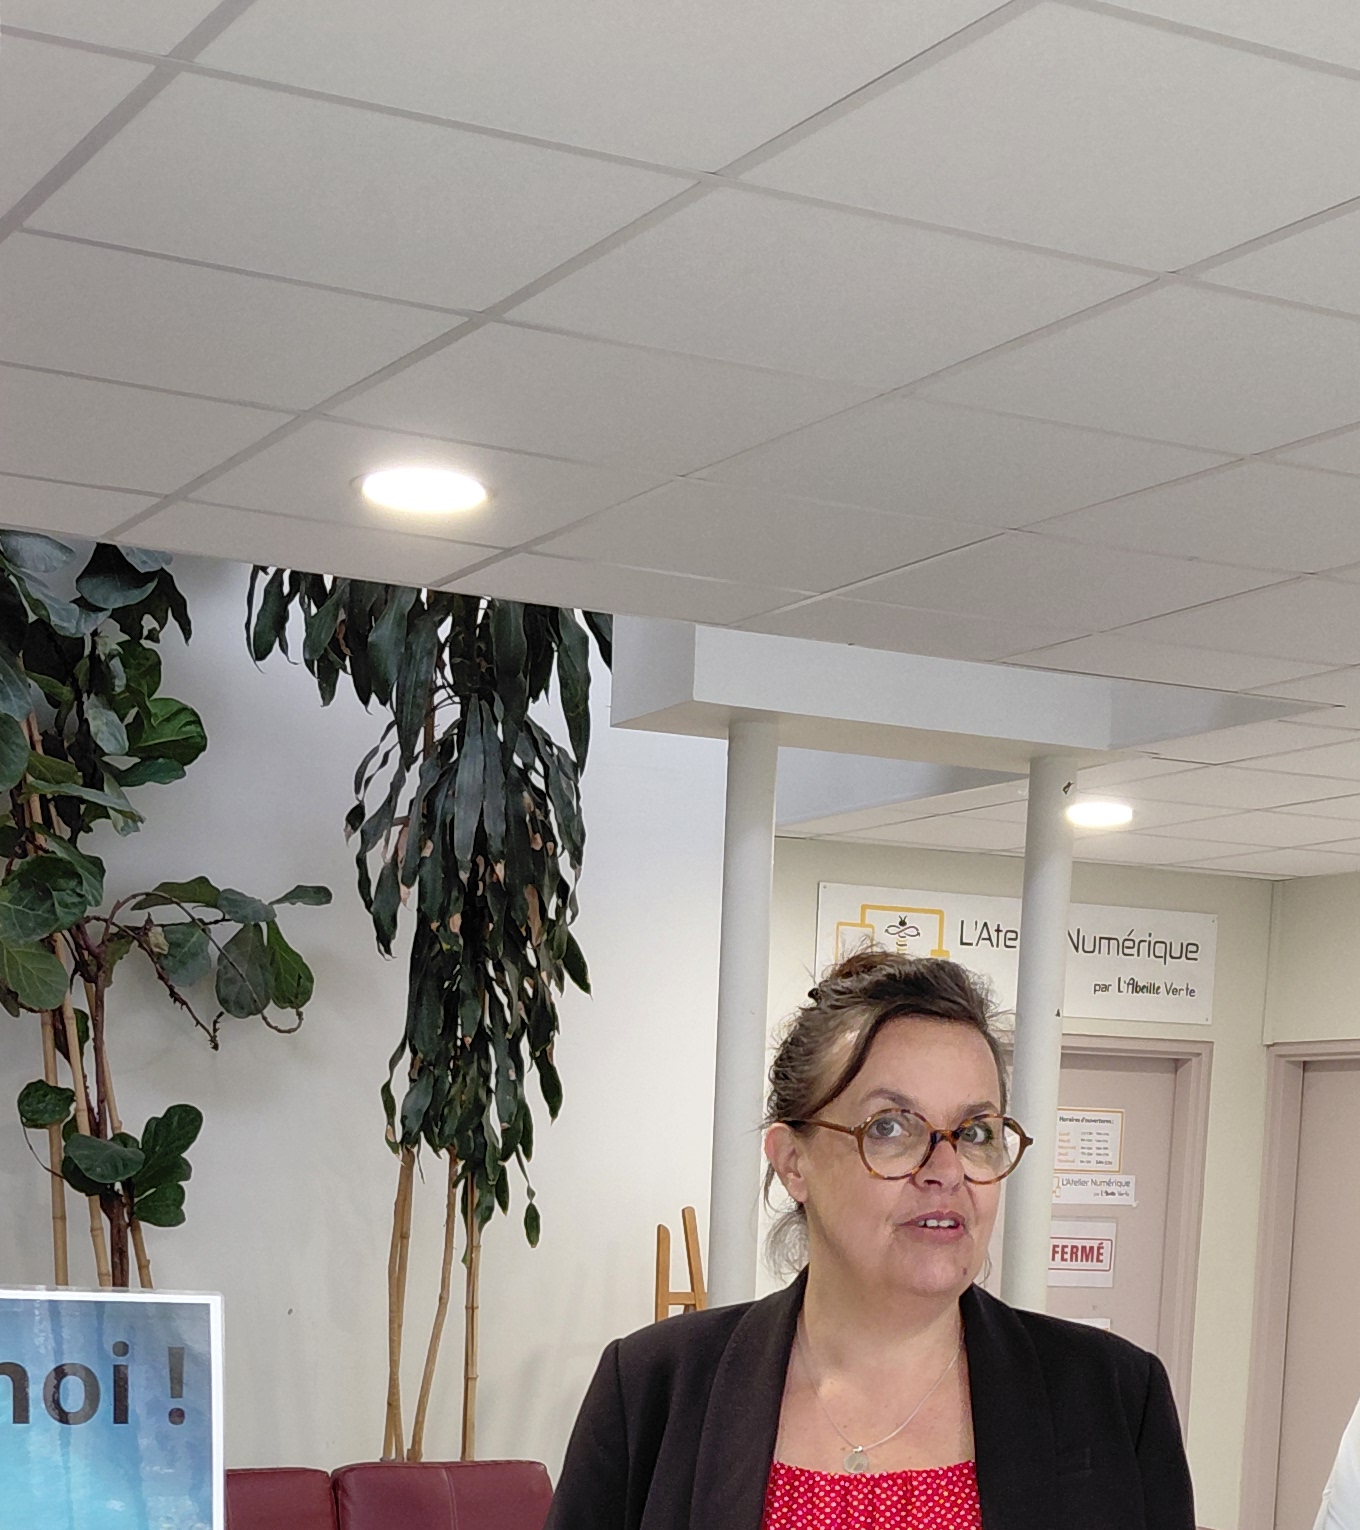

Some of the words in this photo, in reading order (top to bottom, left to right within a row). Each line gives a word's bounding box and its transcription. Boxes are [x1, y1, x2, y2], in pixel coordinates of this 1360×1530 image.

[1093, 981, 1112, 995] par
[1117, 977, 1161, 996] L'Abeille
[1164, 981, 1196, 998] Verte
[1061, 1178, 1089, 1187] L'Atelier
[1090, 1178, 1131, 1188] Numérique
[1051, 1242, 1104, 1263] FERMÉ
[166, 1346, 187, 1426] !
